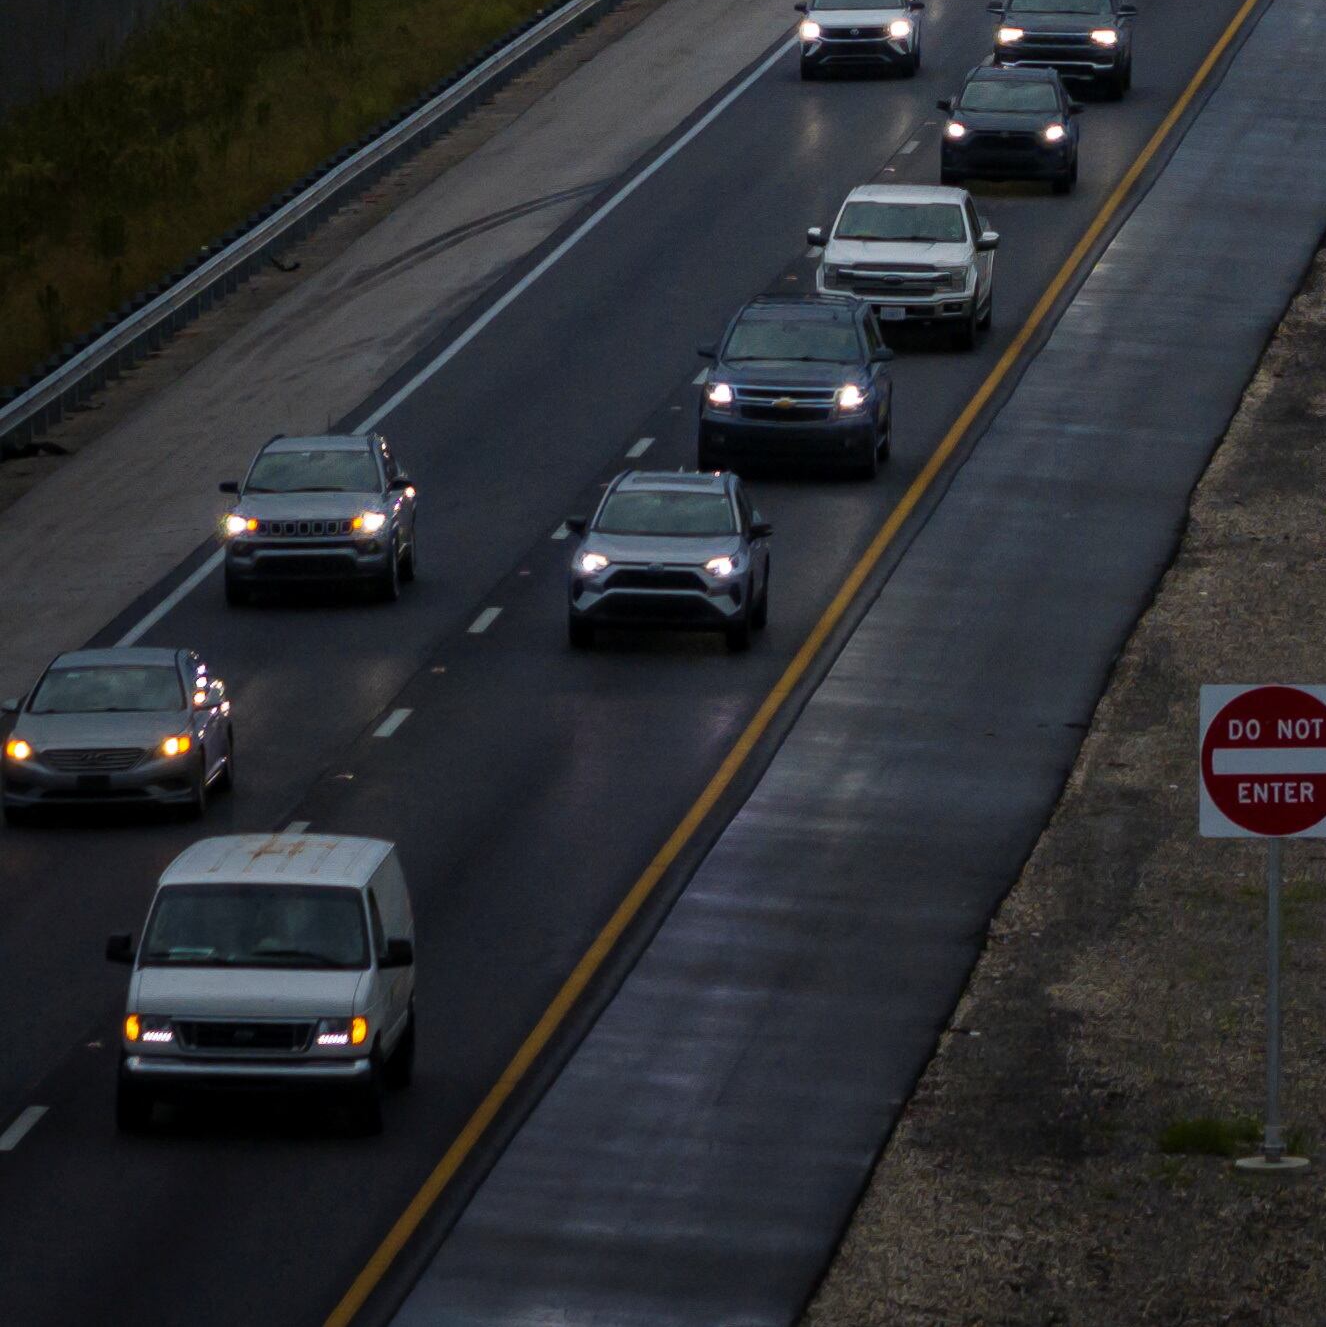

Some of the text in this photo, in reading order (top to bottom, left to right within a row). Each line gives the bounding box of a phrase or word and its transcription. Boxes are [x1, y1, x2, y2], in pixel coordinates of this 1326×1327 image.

[1228, 718, 1324, 741] DO NOT
[1237, 782, 1315, 804] ENTER
